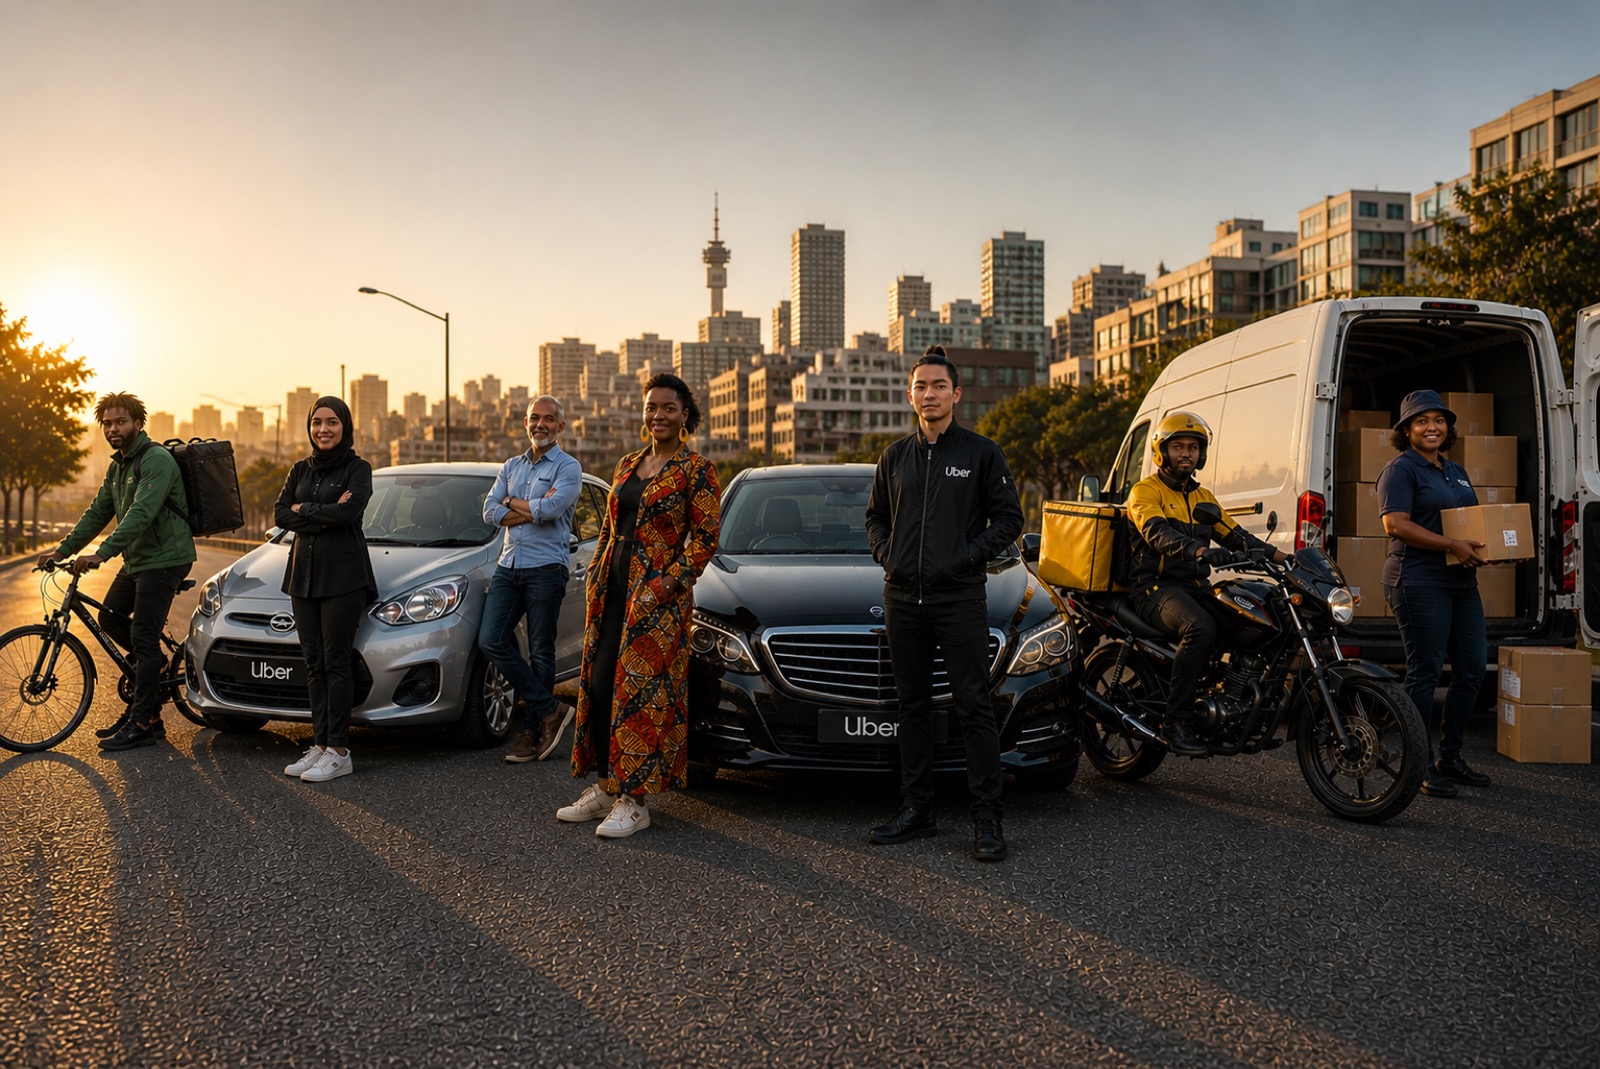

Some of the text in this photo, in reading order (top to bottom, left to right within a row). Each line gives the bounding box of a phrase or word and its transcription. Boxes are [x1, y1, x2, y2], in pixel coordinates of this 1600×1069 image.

[945, 466, 971, 478] Uber
[251, 661, 293, 680] Uber
[845, 716, 900, 737] Uber
